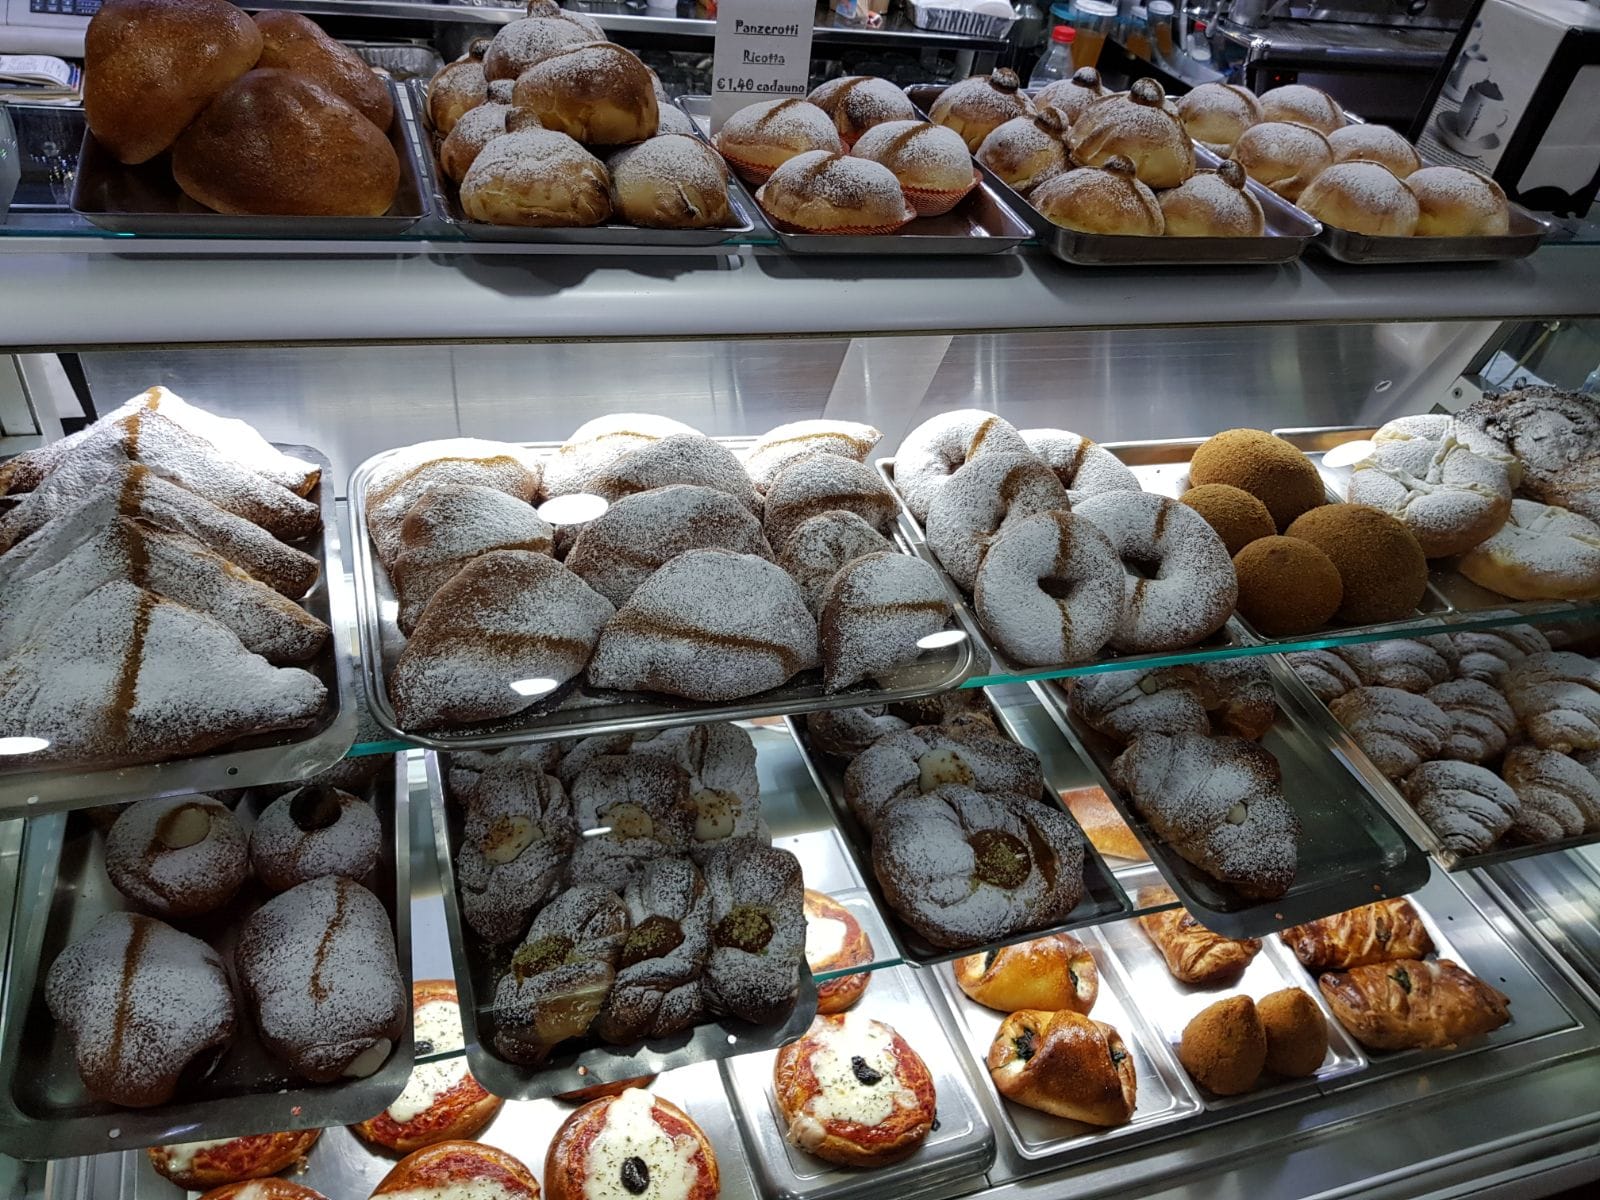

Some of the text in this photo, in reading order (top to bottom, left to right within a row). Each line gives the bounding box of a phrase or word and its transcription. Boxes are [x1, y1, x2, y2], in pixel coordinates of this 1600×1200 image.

[735, 19, 799, 36] Panzerotti
[743, 49, 785, 64] Ricotta
[756, 80, 805, 93] cadauno
